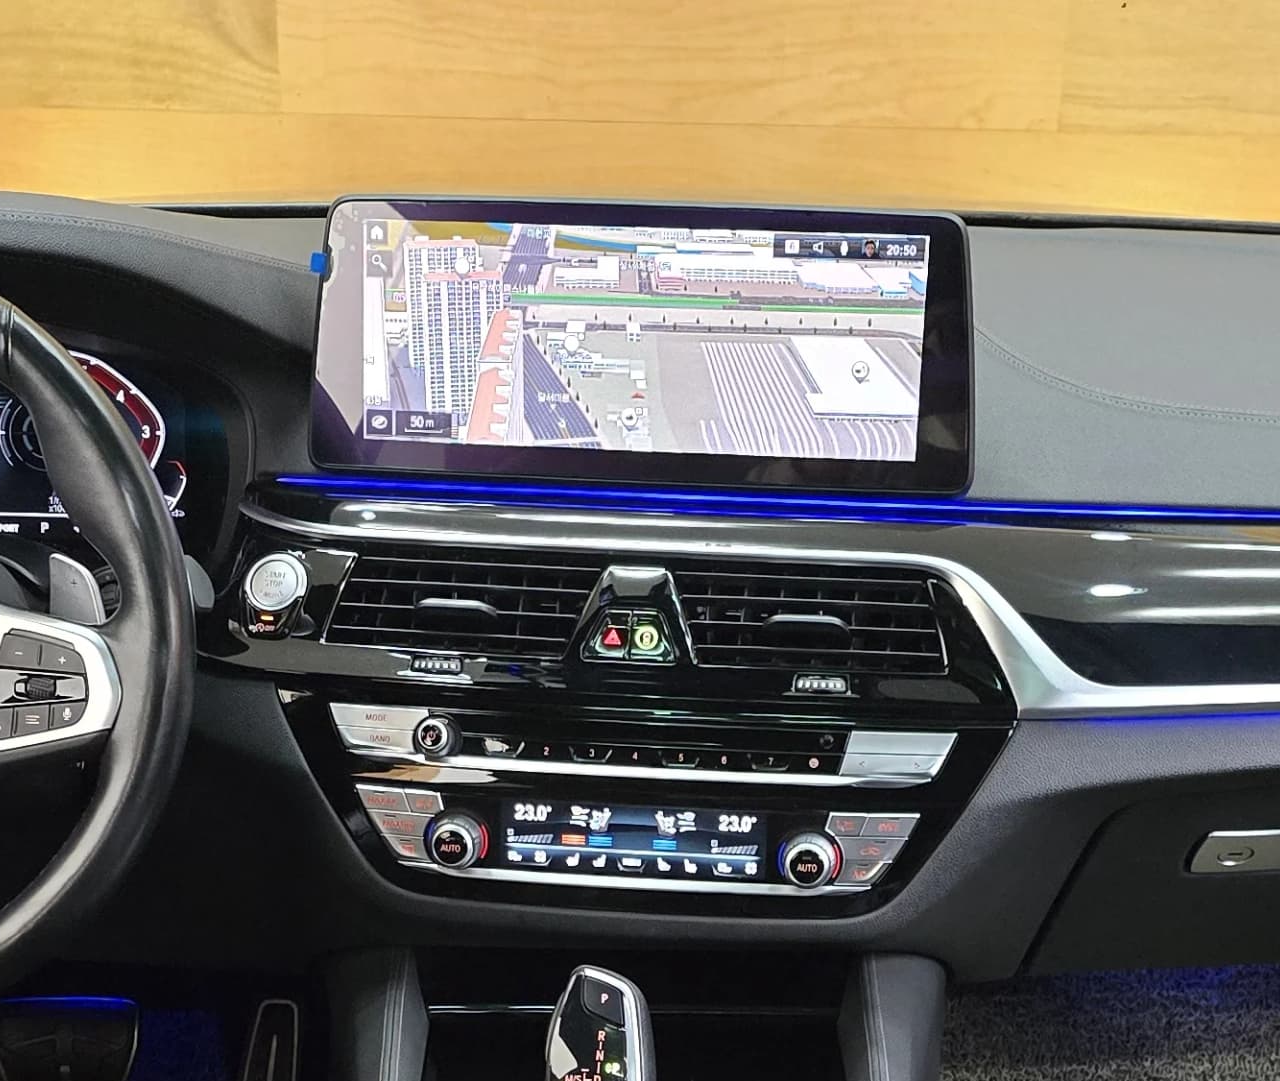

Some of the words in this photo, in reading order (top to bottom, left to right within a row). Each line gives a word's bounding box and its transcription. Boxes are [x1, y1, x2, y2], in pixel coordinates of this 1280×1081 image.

[886, 244, 917, 256] 20:50
[115, 389, 125, 403] 4
[409, 415, 425, 428] 50
[426, 418, 434, 428] m
[141, 425, 151, 438] 3
[40, 521, 50, 534] P
[365, 713, 388, 722] MODE
[543, 746, 549, 756] 2
[589, 748, 595, 758] 3
[632, 751, 638, 760] 4
[677, 752, 684, 762] 5
[721, 755, 727, 765] 6
[767, 757, 774, 766] 7
[440, 843, 461, 853] AUTO
[796, 863, 818, 873] AUTO
[600, 993, 609, 1004] P
[597, 1030, 606, 1041] R
[595, 1050, 605, 1061] N
